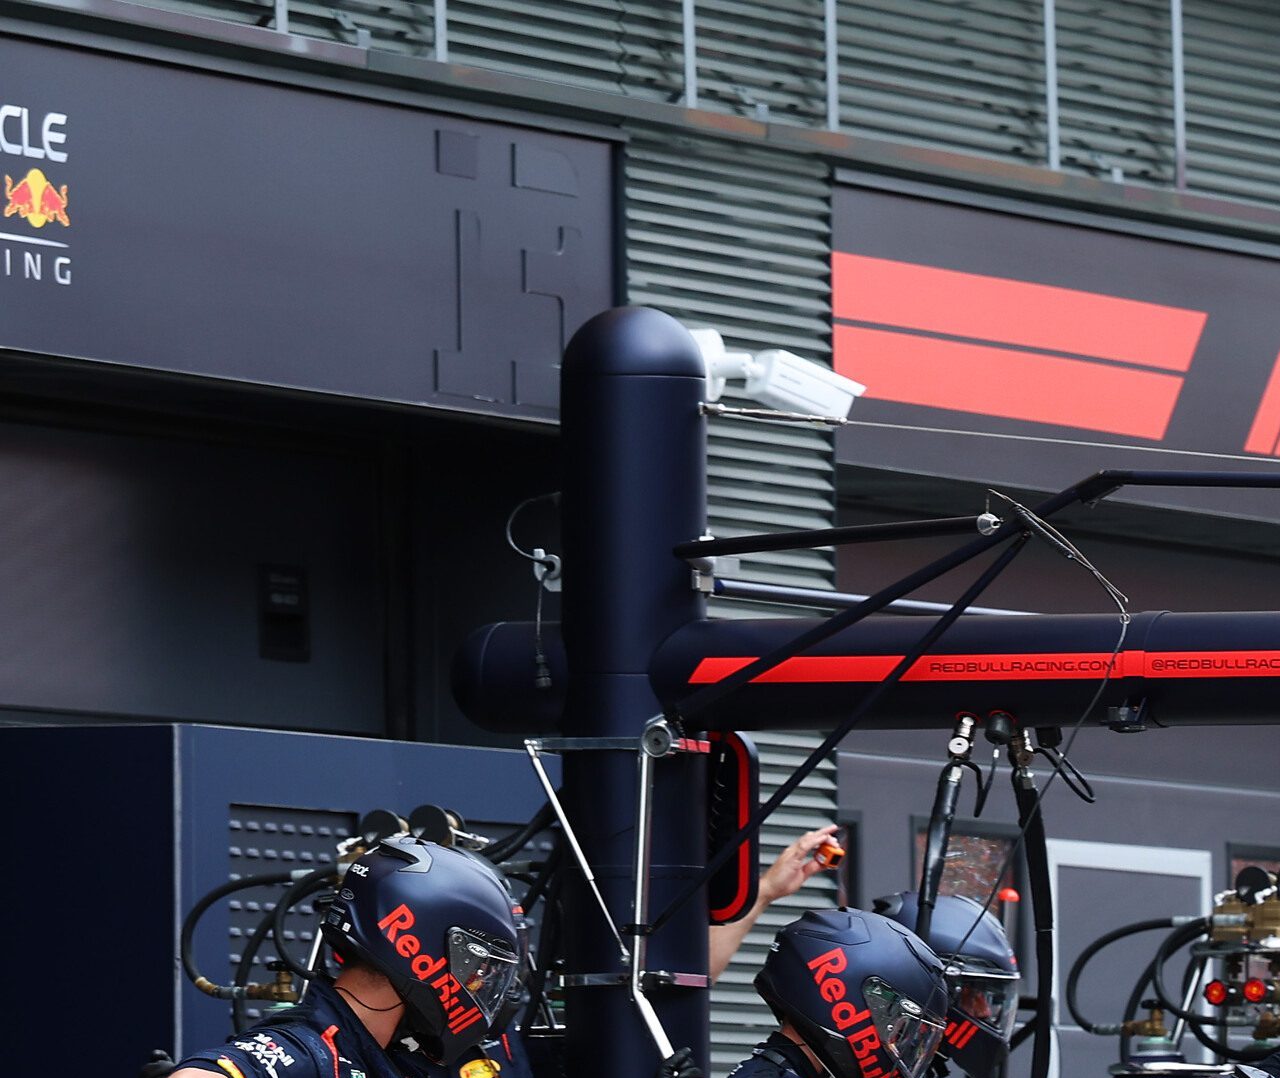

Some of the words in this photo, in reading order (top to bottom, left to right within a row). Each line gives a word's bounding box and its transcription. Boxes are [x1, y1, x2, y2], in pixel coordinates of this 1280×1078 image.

[0, 104, 69, 163] CLE
[928, 658, 1117, 675] REDBULLRACING.COM
[376, 903, 449, 981] Red
[806, 946, 871, 1029] Red
